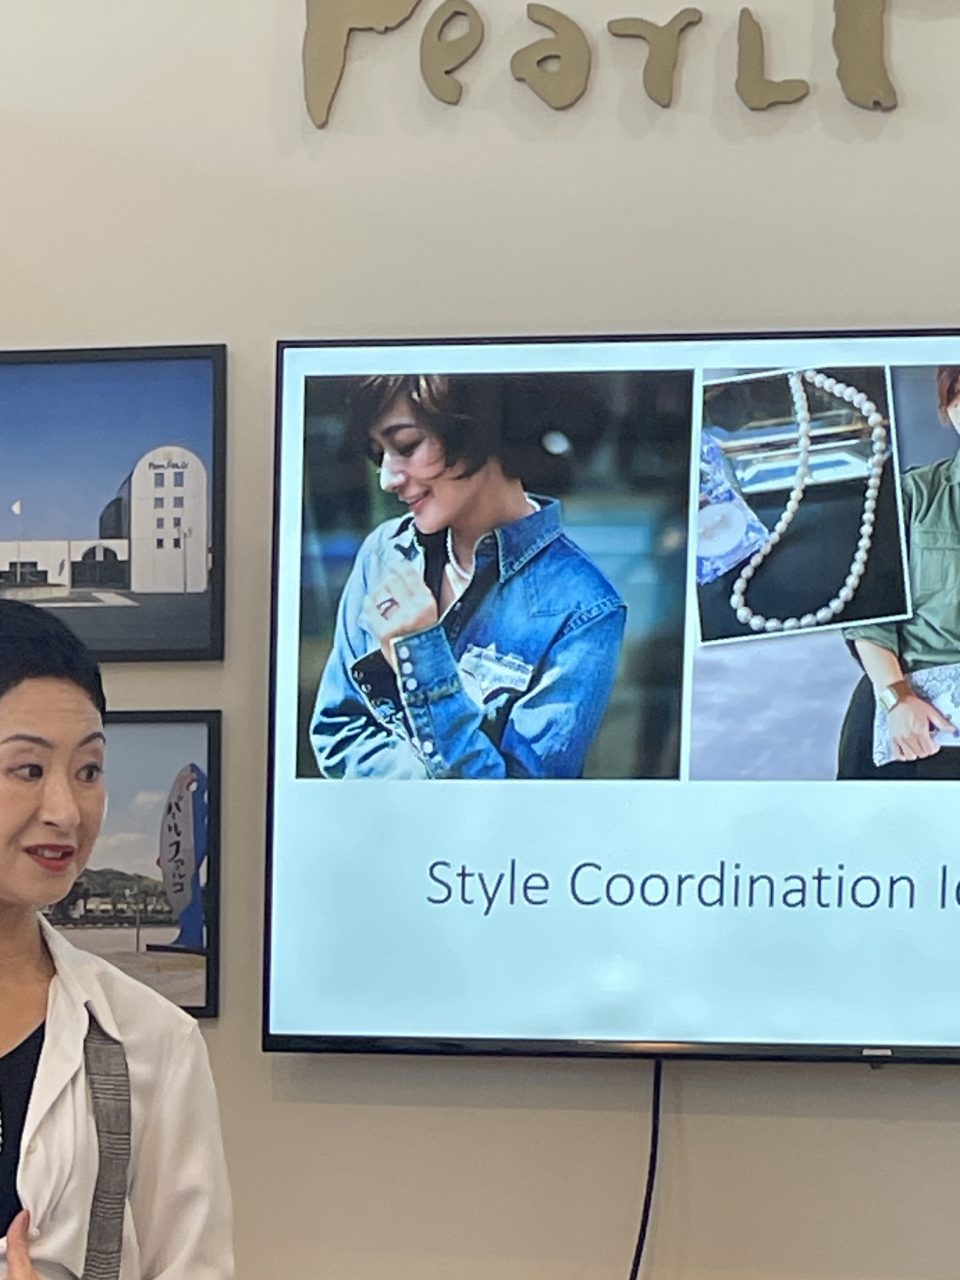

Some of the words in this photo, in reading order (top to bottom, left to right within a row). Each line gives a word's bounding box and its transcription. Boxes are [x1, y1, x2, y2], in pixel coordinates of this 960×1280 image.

[426, 858, 549, 917] Style
[570, 860, 915, 909] Coordination
[940, 864, 960, 909] I
